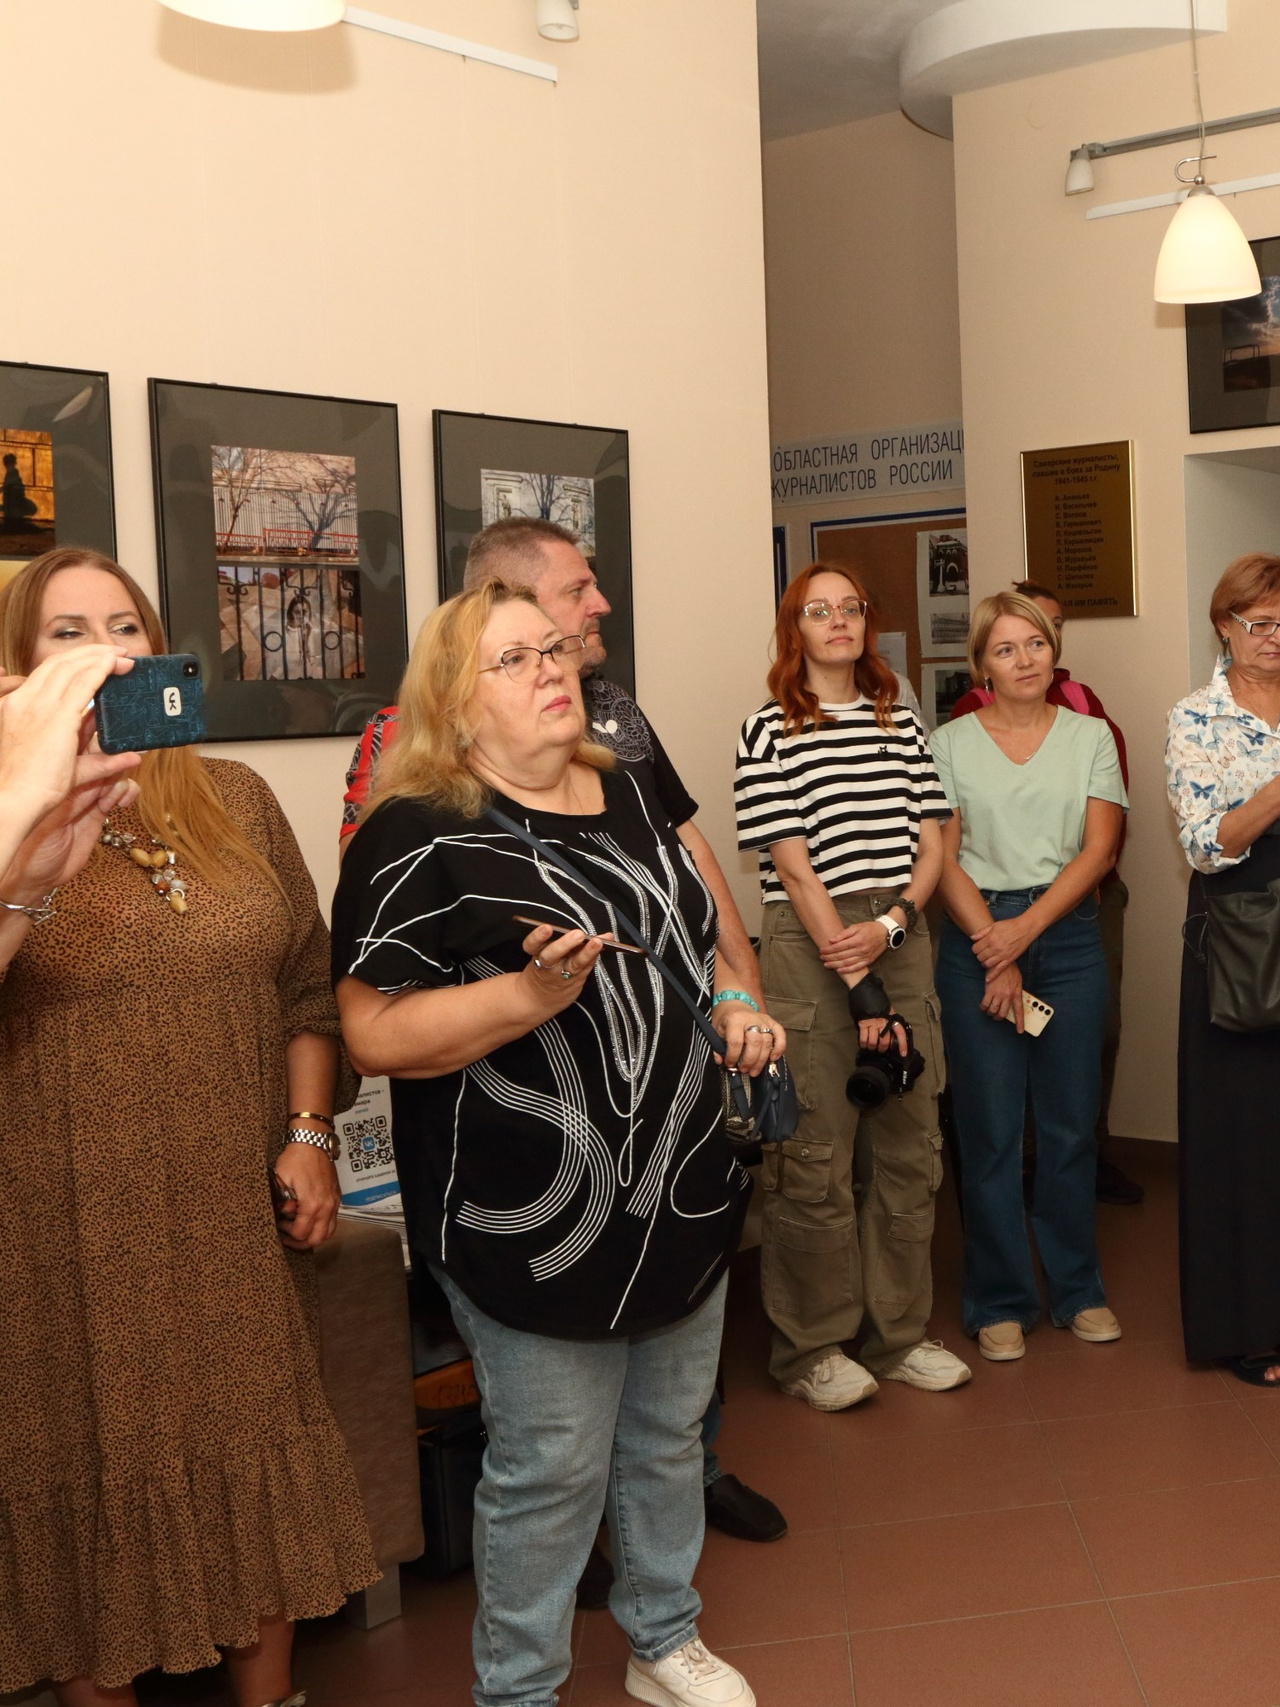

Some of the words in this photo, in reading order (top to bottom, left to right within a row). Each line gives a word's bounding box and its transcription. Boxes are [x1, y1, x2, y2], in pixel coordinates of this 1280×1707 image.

[773, 443, 858, 472] ОБЛАСТНАЯ
[871, 430, 964, 460] ОРГАНИЗАЦ
[890, 459, 953, 485] РОССИИ
[1094, 464, 1121, 473] Родину
[1055, 475, 1088, 485] 1941-1945
[1064, 546, 1092, 555] Морозов
[1087, 598, 1118, 607] ПАМЯТЬ
